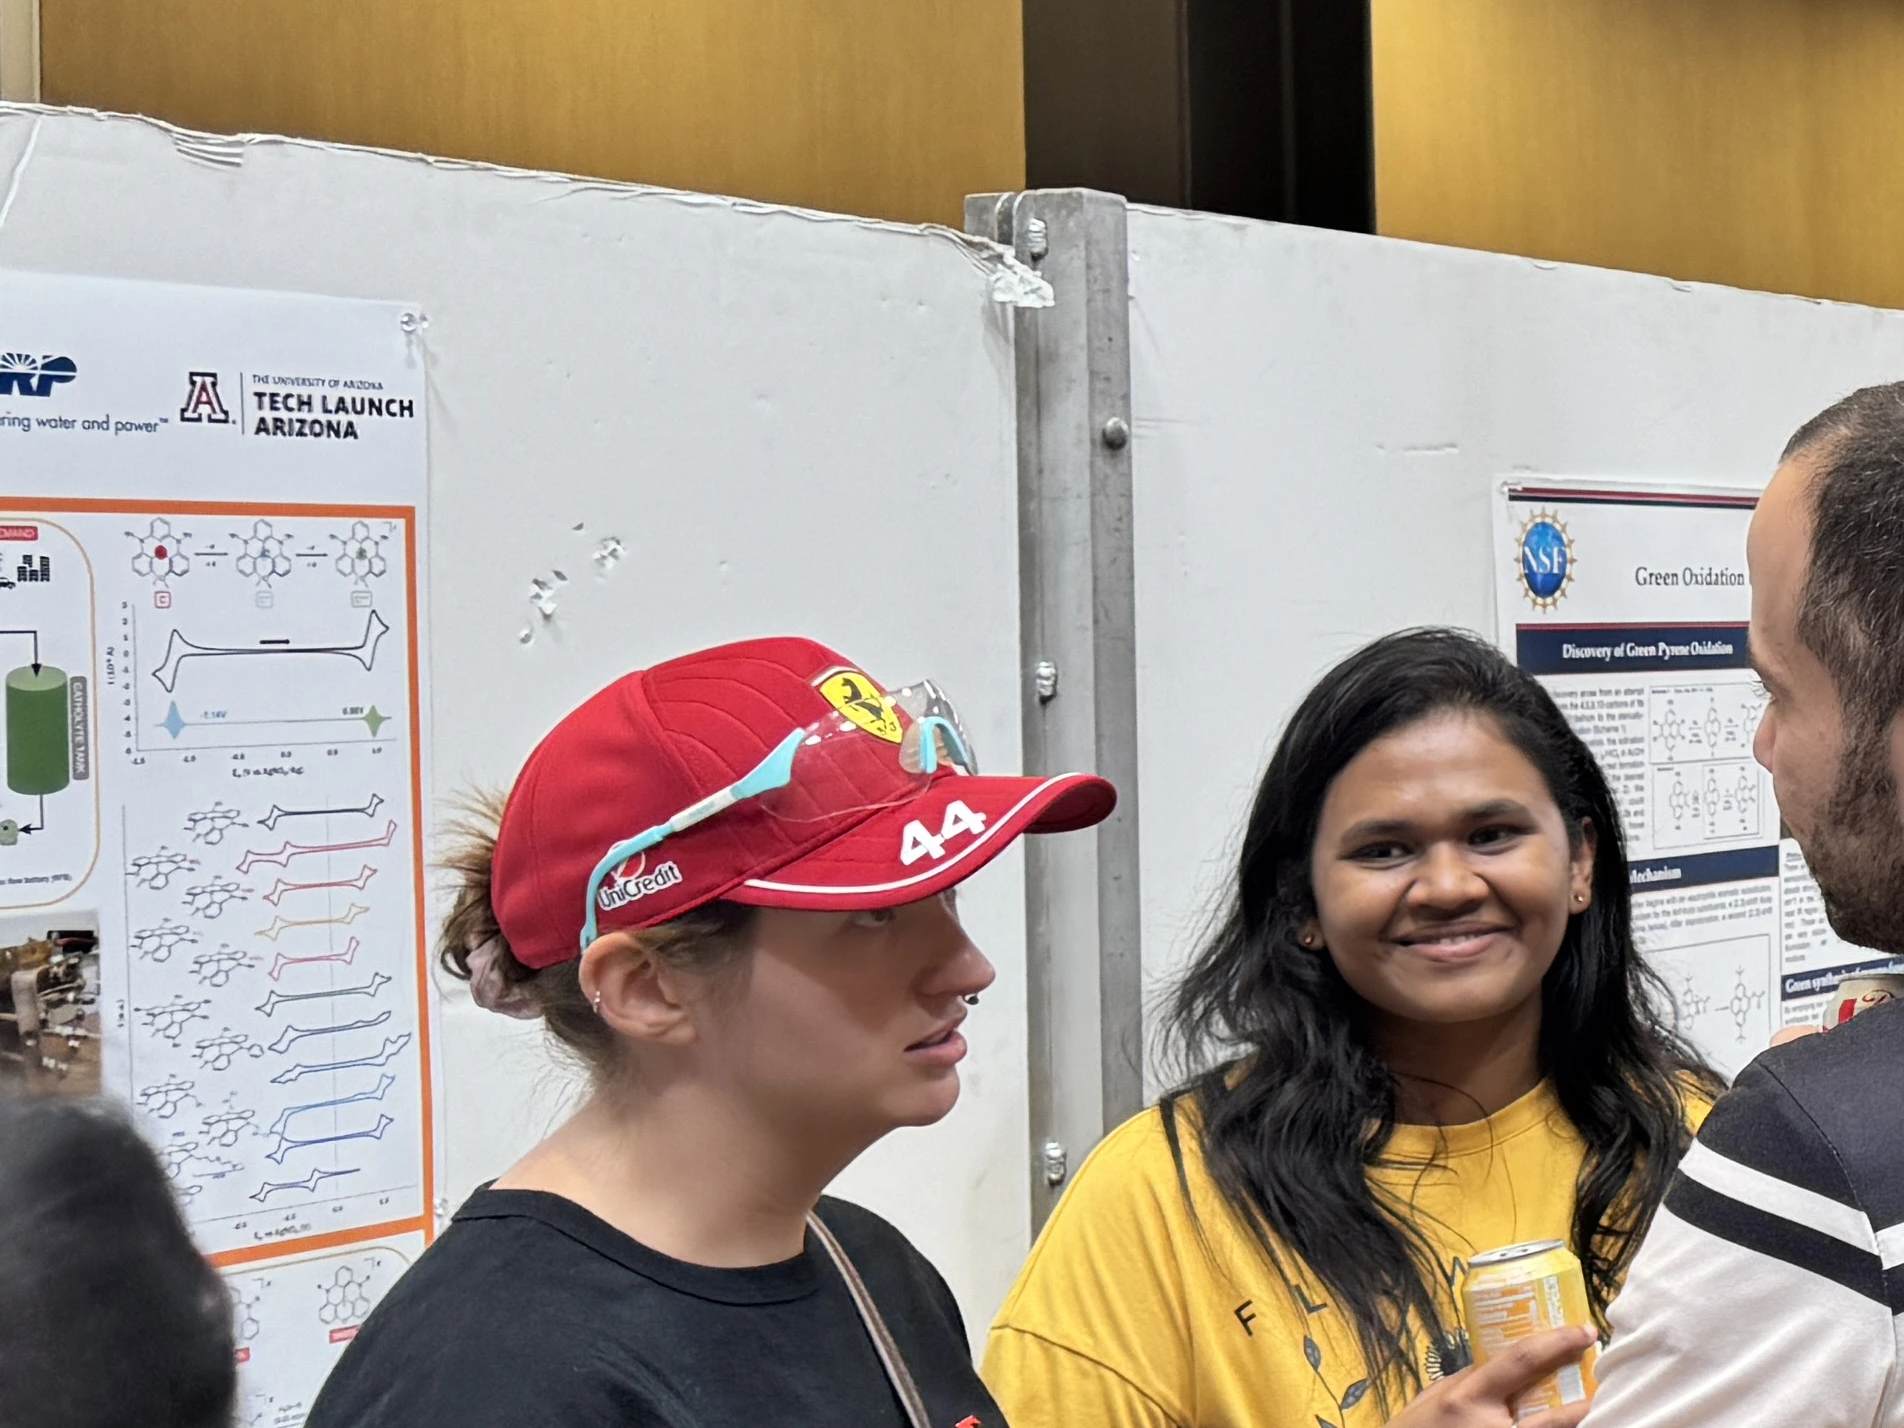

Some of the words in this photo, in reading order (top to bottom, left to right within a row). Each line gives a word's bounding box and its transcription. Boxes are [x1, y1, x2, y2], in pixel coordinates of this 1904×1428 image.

[253, 391, 313, 414] TECH
[322, 395, 414, 418] LAUNCH
[35, 415, 77, 430] water
[81, 413, 110, 431] and
[254, 417, 359, 440] ARIZONA
[1524, 546, 1566, 574] NSF
[1635, 566, 1679, 587] Green
[1682, 566, 1745, 587] Oxidation
[1562, 643, 1612, 662] Discovery
[1614, 642, 1626, 658] of
[1626, 642, 1656, 658] Green
[900, 800, 987, 866] 44
[600, 864, 679, 908] UniCredit
